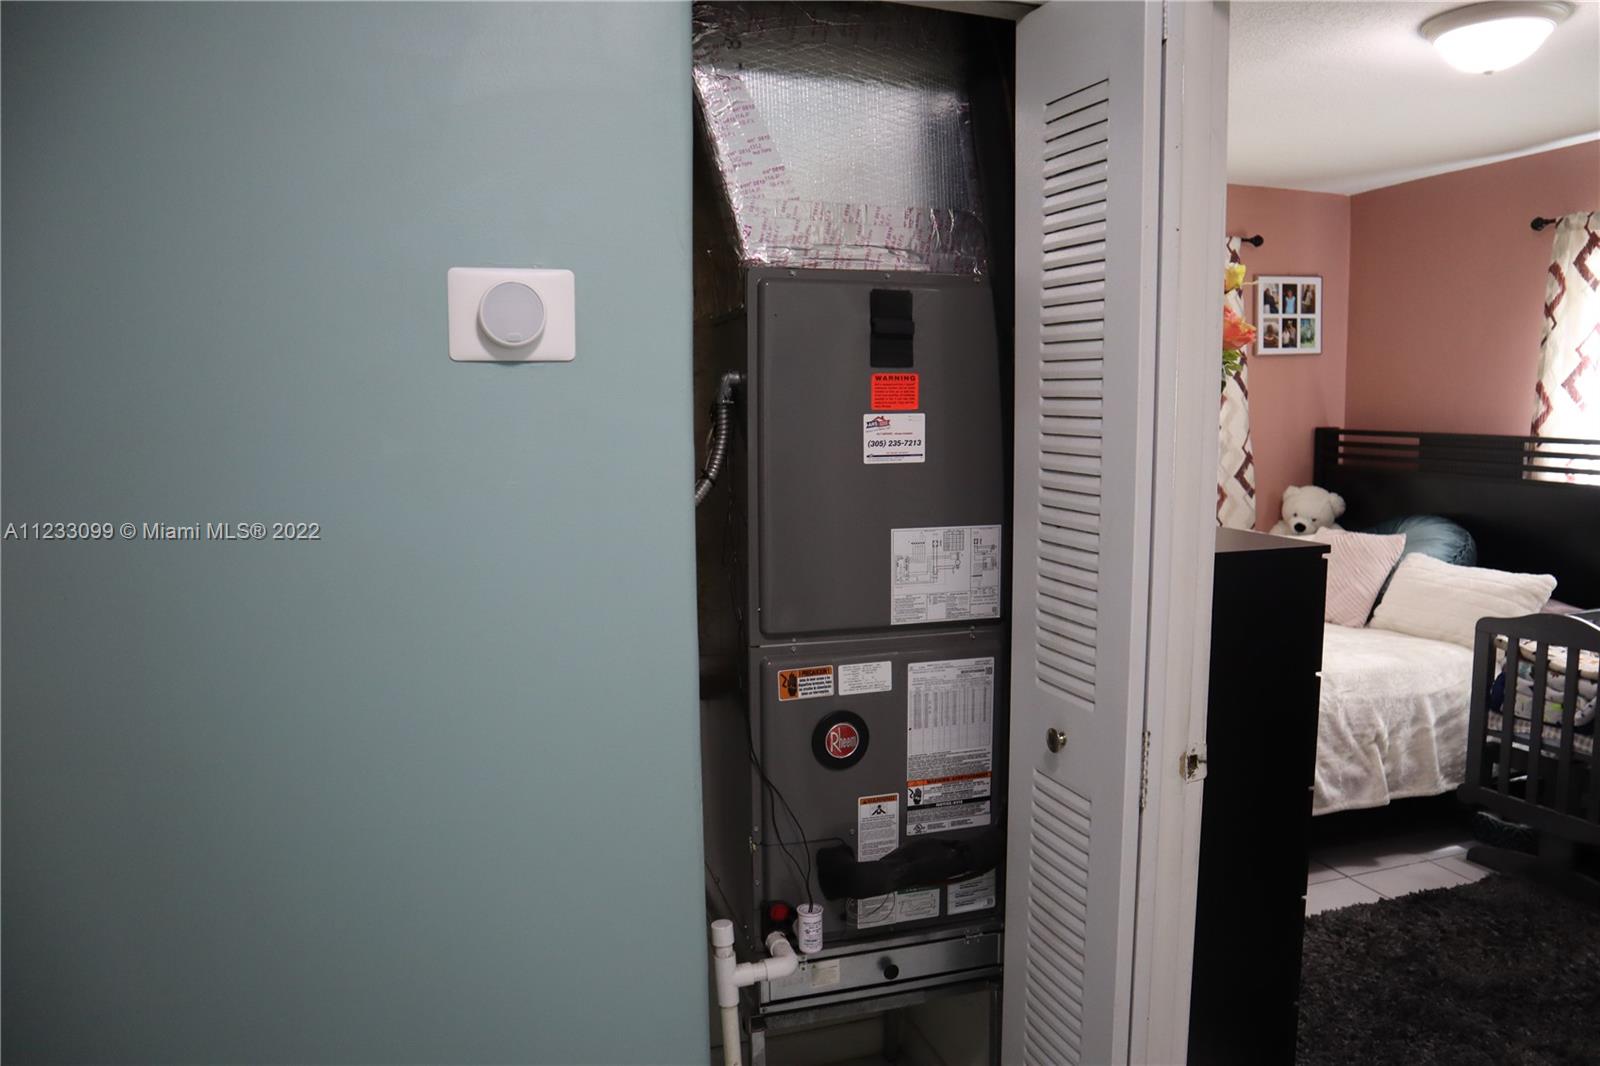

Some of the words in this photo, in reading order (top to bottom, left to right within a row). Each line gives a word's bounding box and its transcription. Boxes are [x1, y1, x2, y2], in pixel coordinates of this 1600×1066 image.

[867, 440, 887, 448] (305)
[888, 439, 922, 447] 235-7213
[830, 727, 858, 752] Rheem
